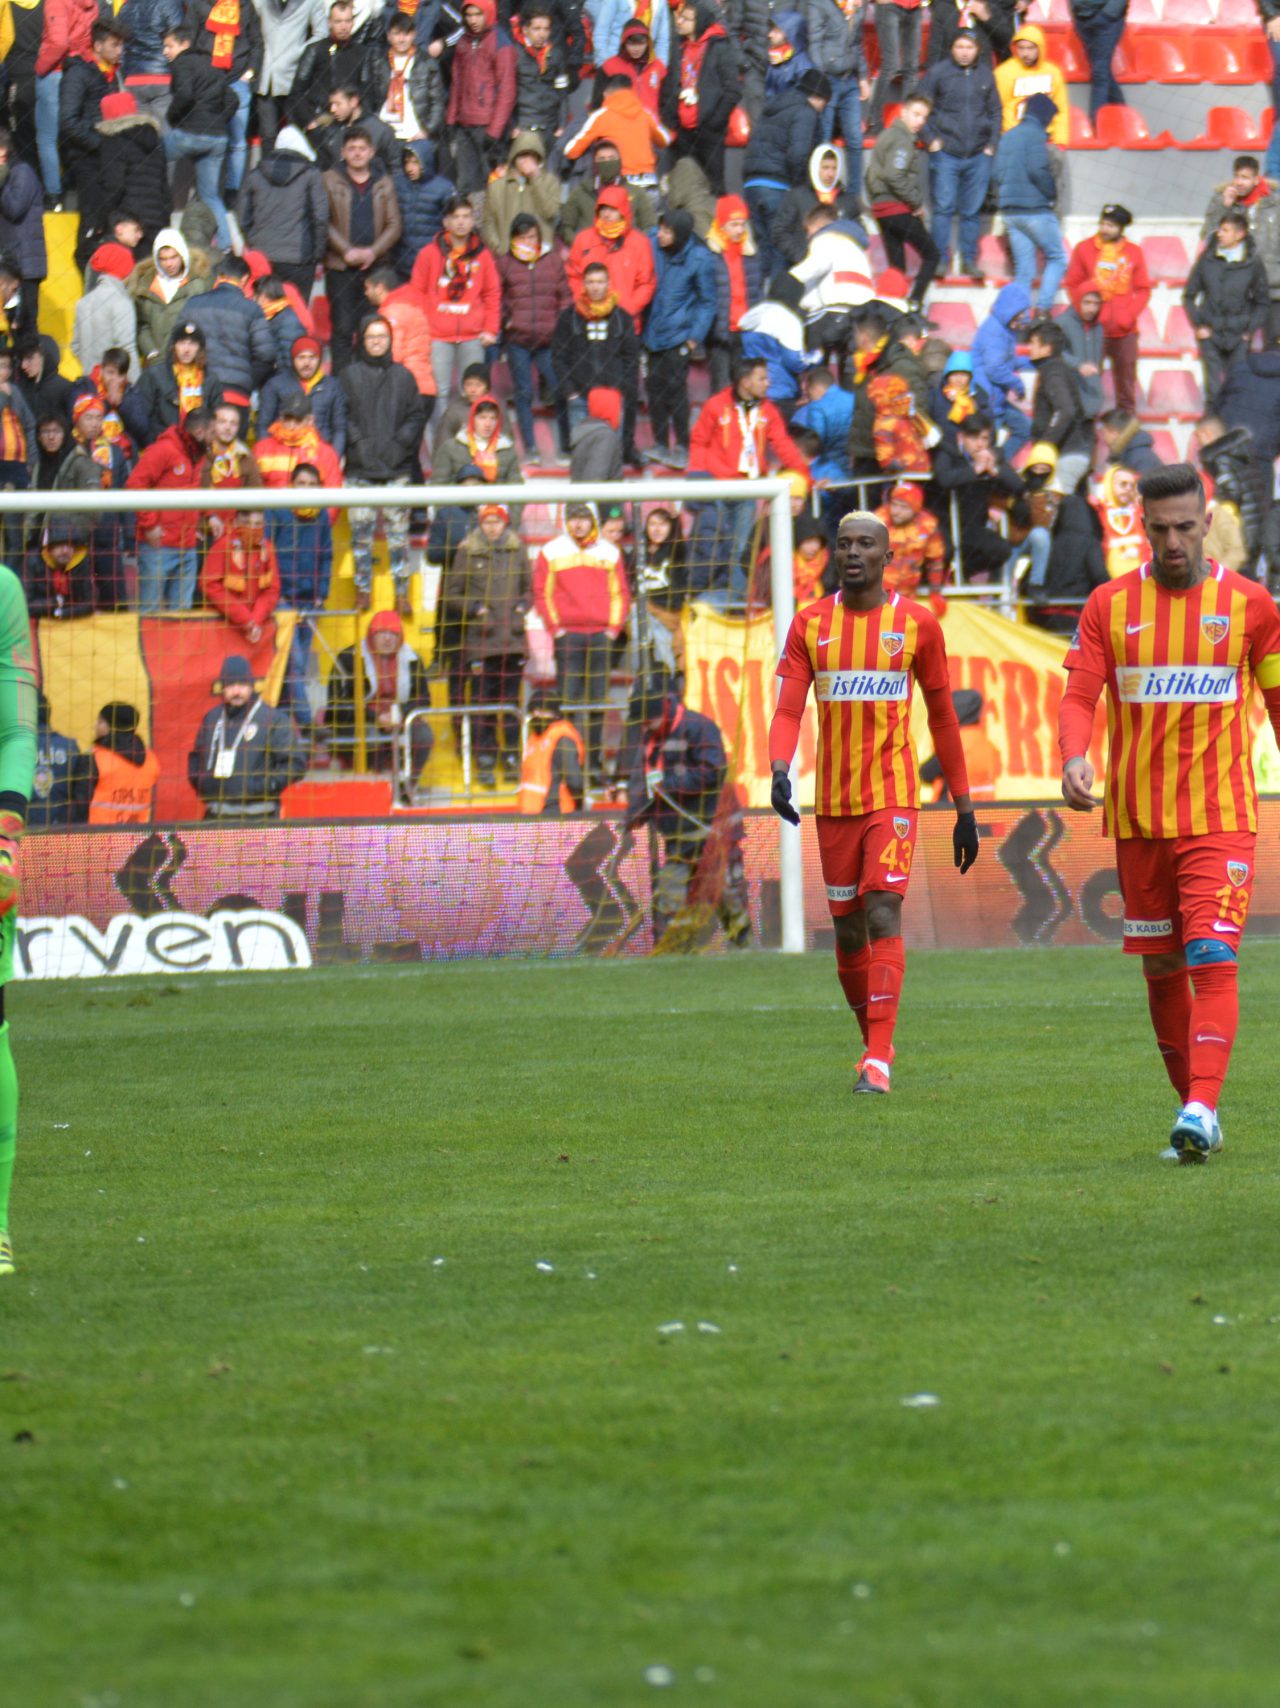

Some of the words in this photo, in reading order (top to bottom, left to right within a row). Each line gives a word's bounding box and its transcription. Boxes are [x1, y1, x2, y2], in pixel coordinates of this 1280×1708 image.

[832, 674, 906, 696] istikbal
[1145, 671, 1235, 696] istikbal
[879, 838, 911, 874] 43
[1215, 884, 1249, 926] 13
[1136, 923, 1171, 933] KABLO
